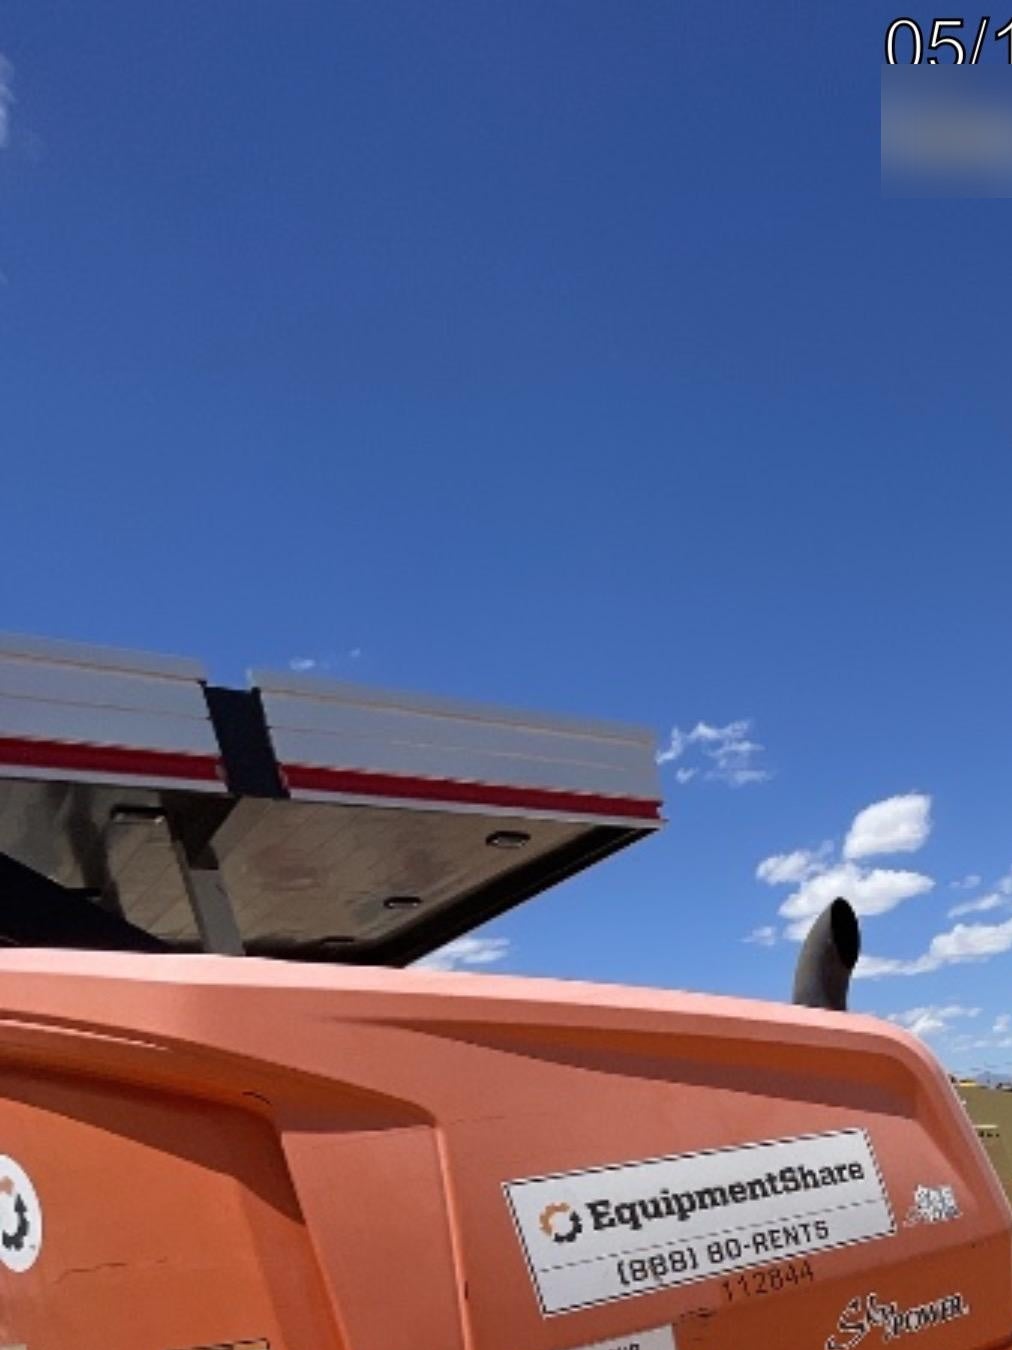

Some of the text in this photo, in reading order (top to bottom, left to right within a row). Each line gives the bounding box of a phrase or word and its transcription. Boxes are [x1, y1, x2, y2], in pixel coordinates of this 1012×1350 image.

[586, 1160, 865, 1230] EquipmentShare
[617, 1220, 829, 1285] (888) 80-RENTS
[721, 1259, 813, 1301] 112844
